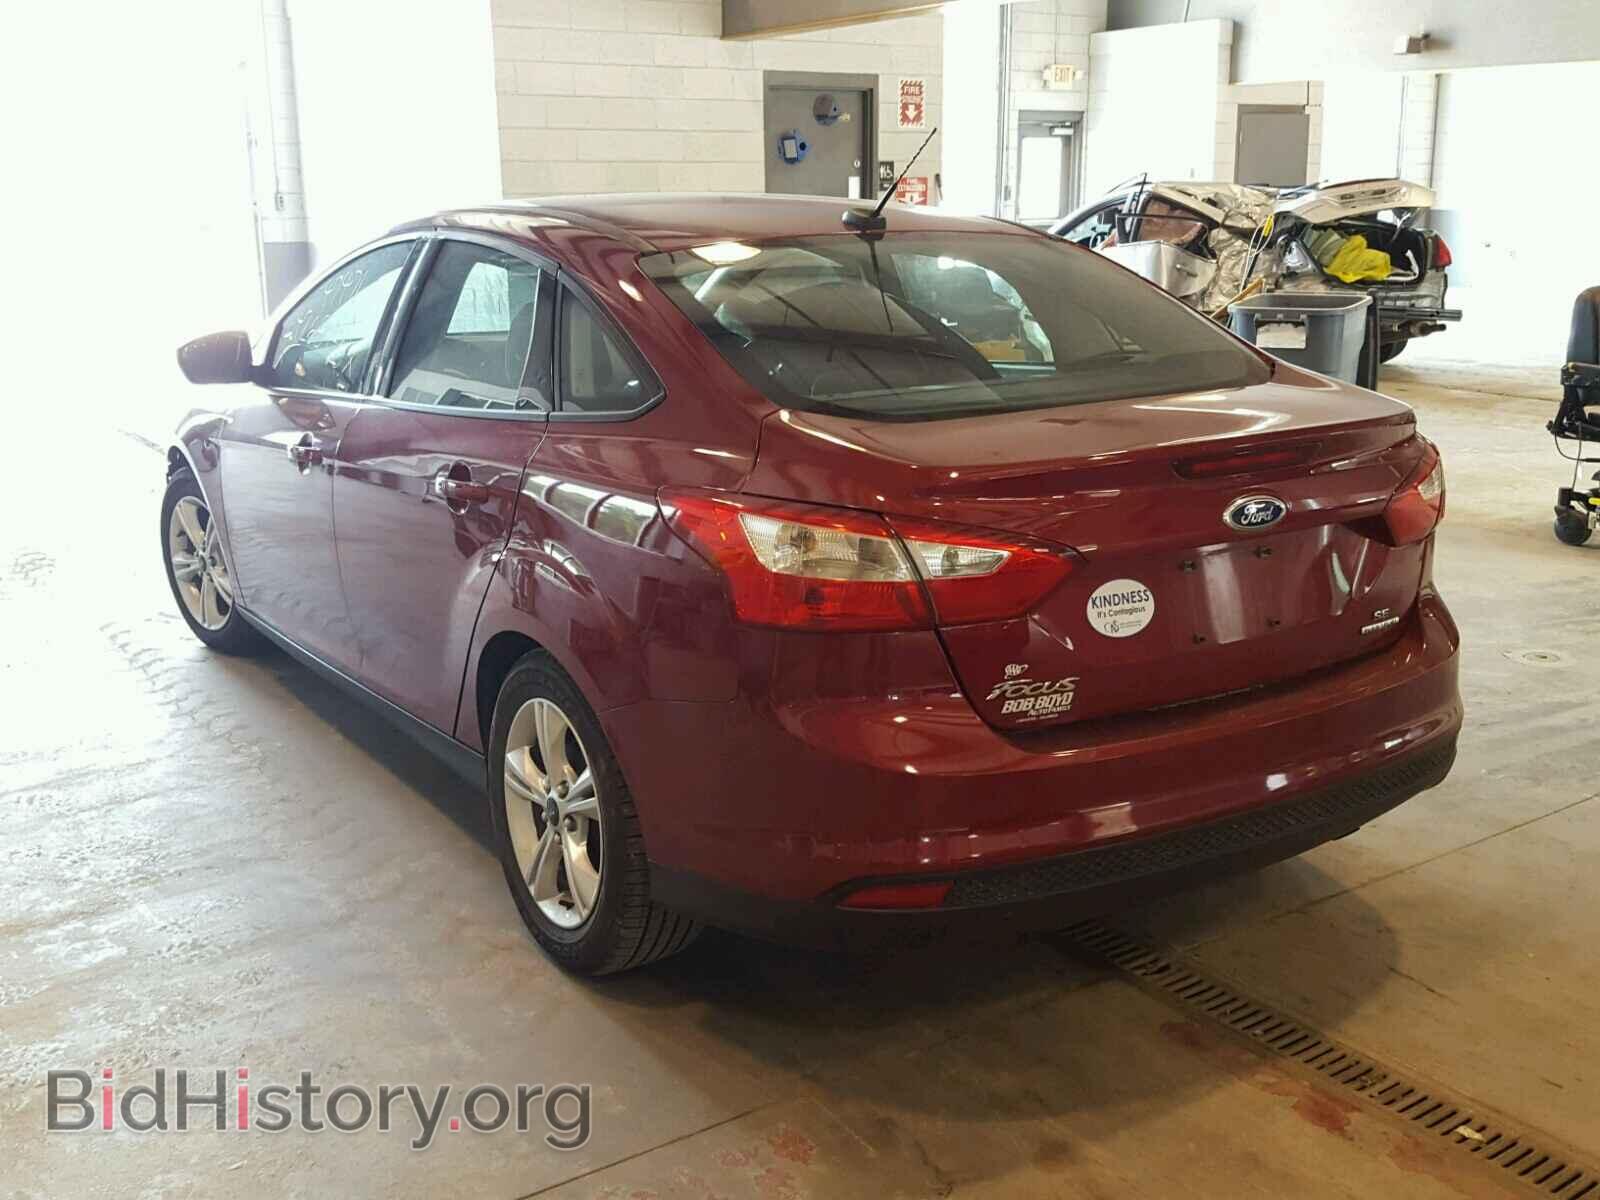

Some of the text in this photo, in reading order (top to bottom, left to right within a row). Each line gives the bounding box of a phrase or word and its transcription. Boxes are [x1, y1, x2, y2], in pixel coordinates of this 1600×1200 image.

[1055, 67, 1070, 82] EXIT
[903, 86, 921, 95] FIRE
[1241, 503, 1274, 525] Ford
[1091, 590, 1150, 609] KINDNESS
[1108, 607, 1146, 617] Contagious
[1001, 692, 1074, 714] BOB BOYD
